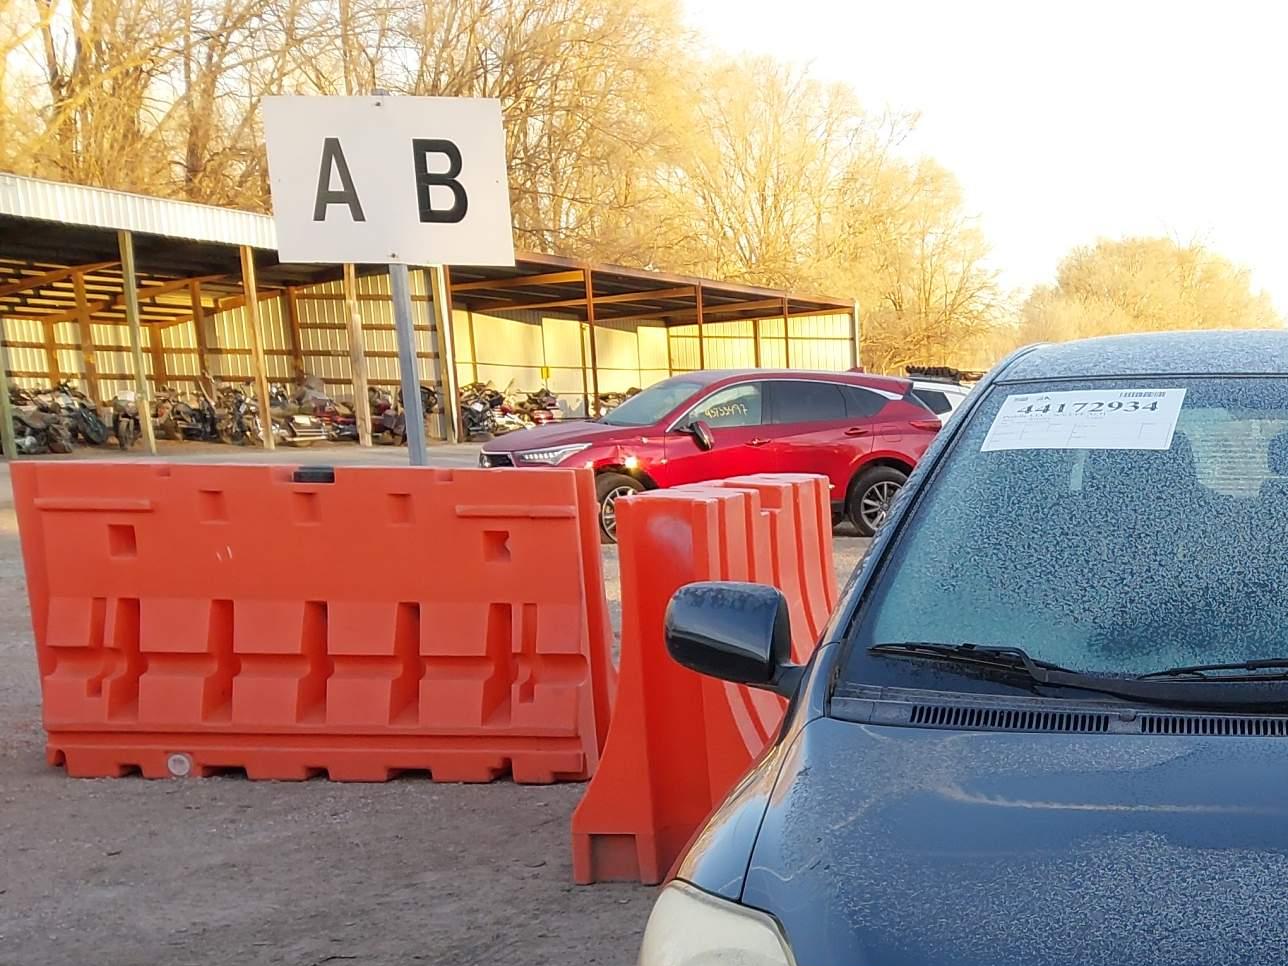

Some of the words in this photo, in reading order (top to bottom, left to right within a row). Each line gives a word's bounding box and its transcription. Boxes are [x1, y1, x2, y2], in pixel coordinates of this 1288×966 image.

[313, 137, 366, 221] A
[412, 138, 468, 223] B
[1017, 400, 1159, 415] 44172934
